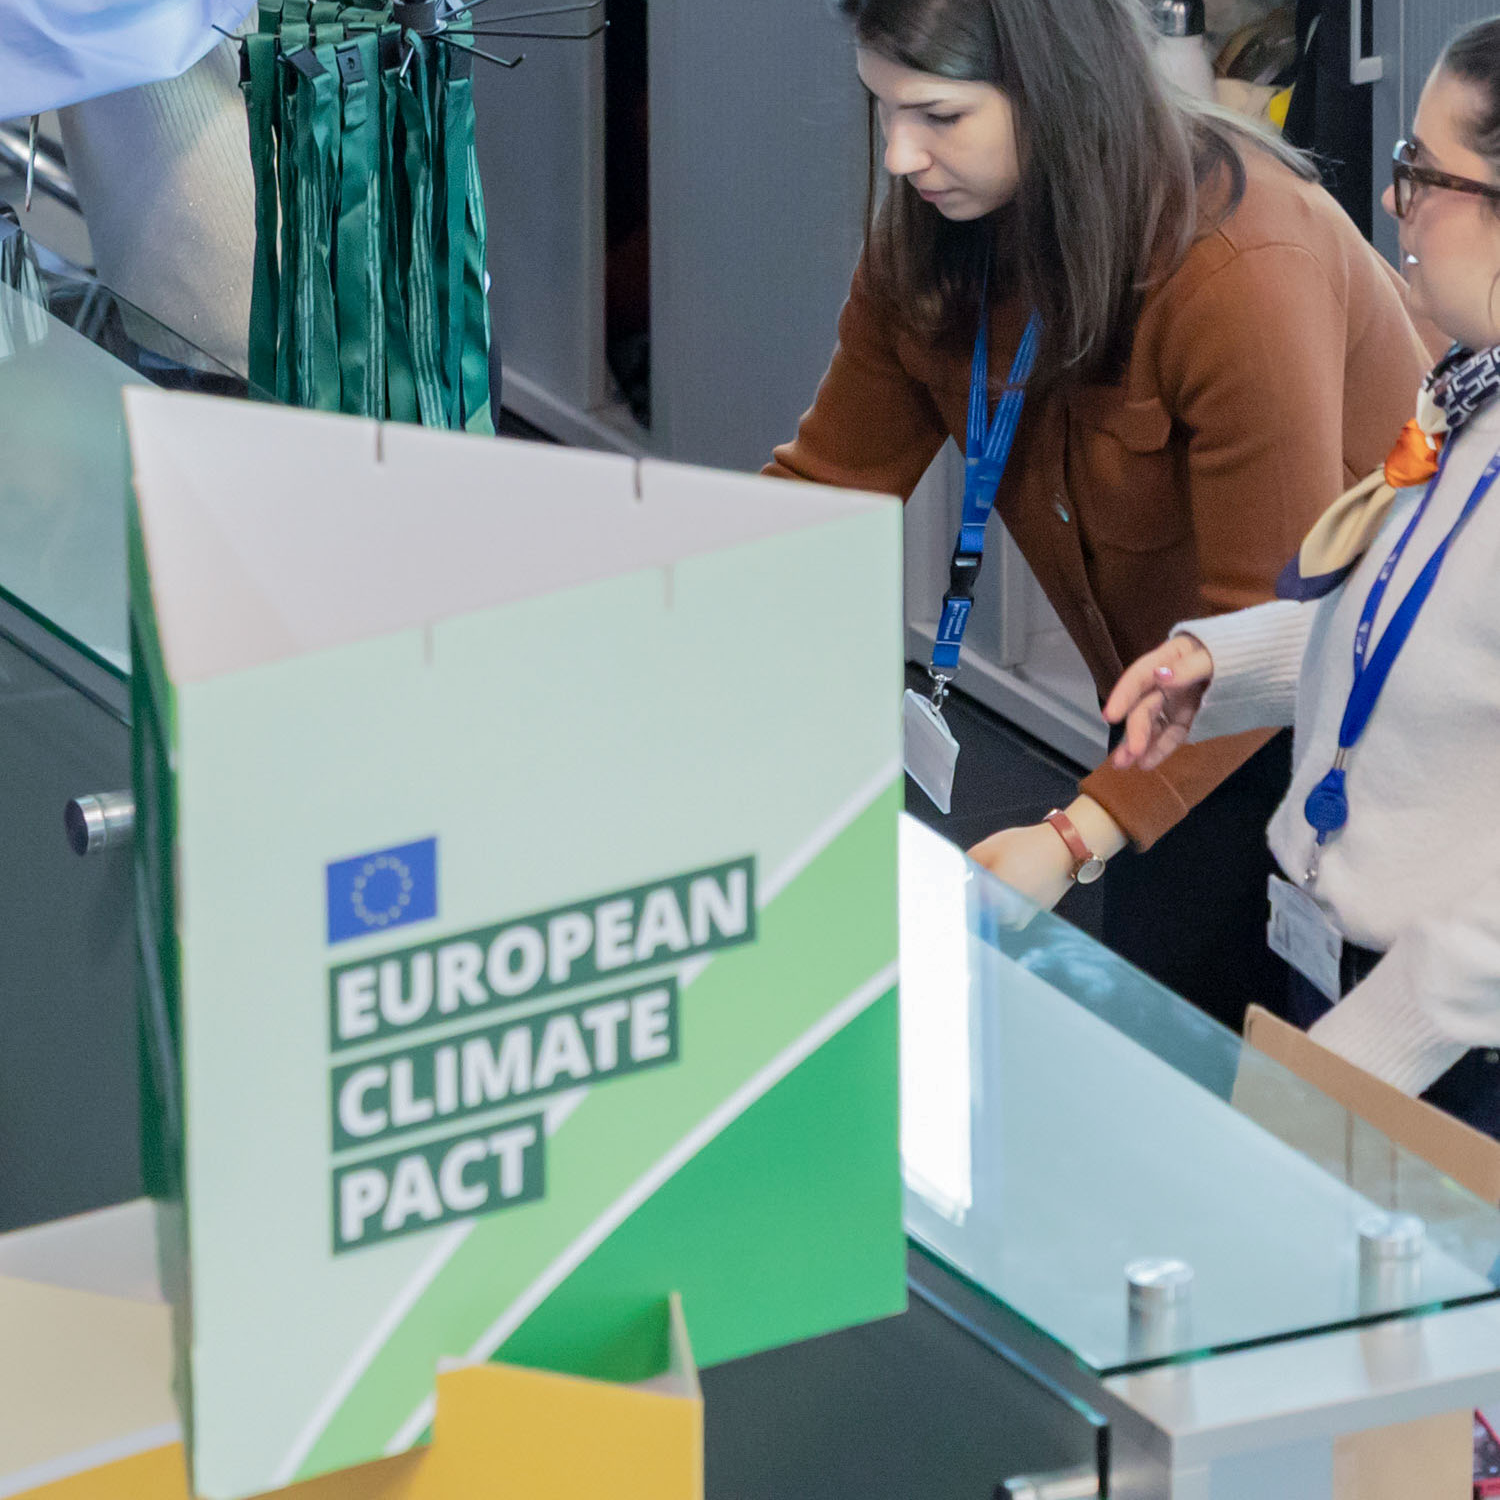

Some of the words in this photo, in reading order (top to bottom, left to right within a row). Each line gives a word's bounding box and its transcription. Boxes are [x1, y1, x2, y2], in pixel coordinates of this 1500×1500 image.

[336, 867, 749, 1041] EUROPEAN
[337, 989, 671, 1138] CLIMATE
[339, 1125, 537, 1245] PACT
